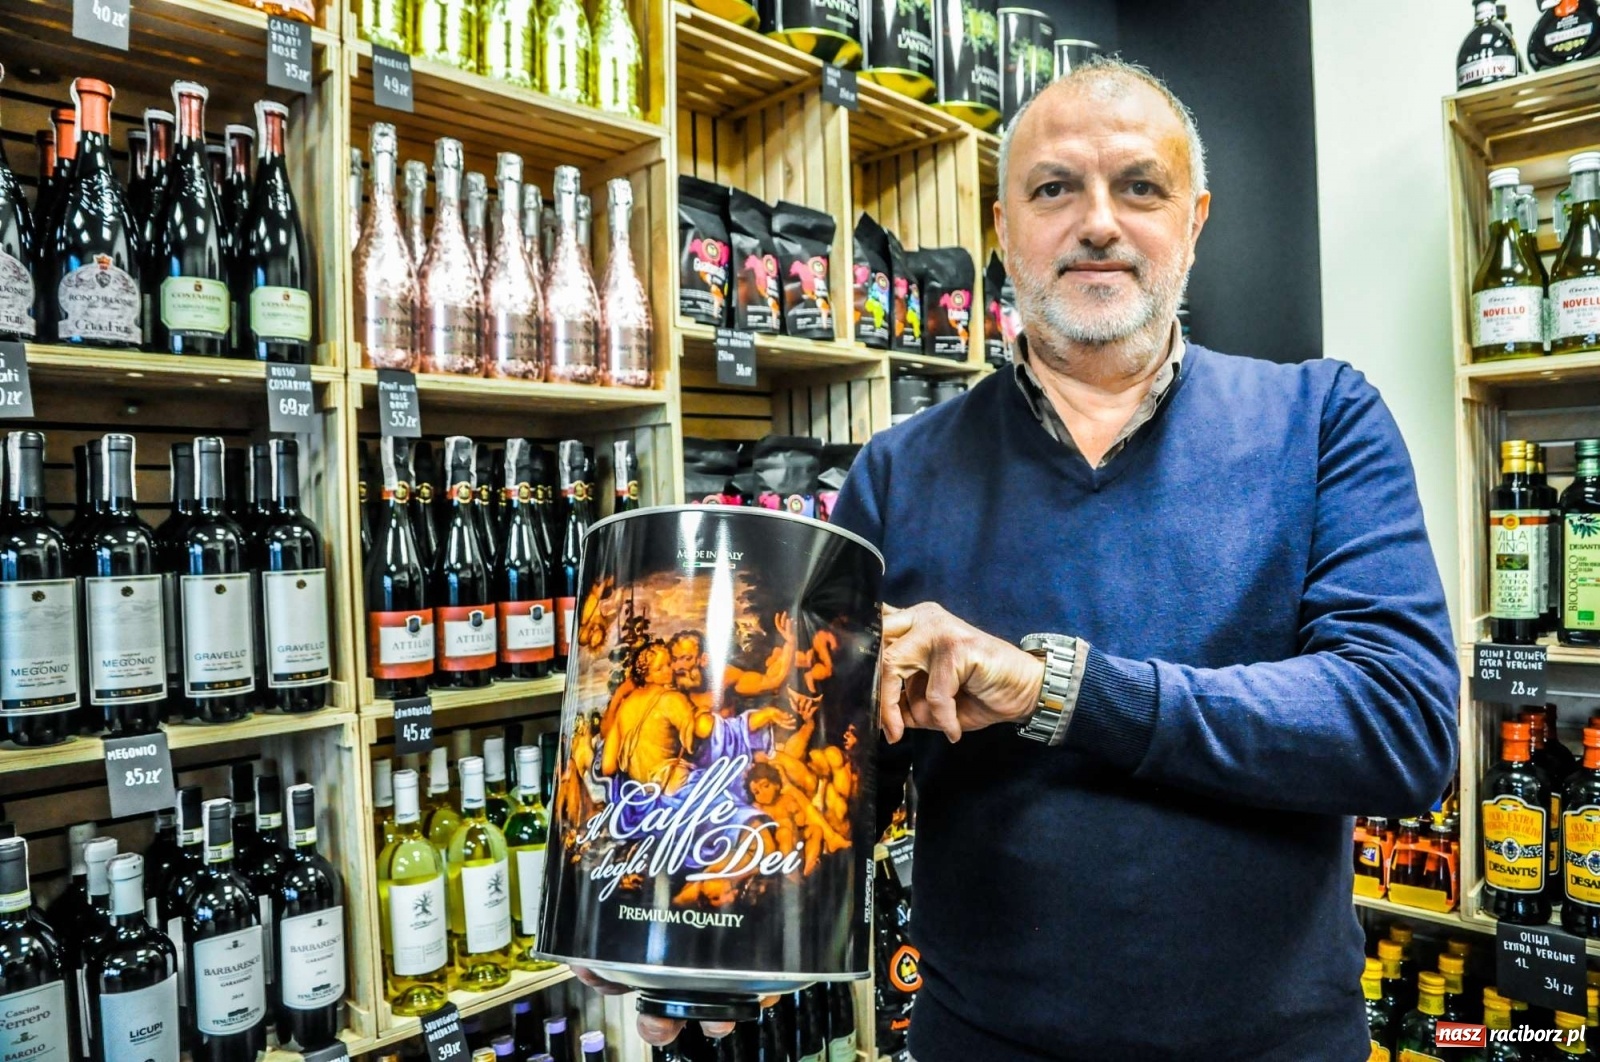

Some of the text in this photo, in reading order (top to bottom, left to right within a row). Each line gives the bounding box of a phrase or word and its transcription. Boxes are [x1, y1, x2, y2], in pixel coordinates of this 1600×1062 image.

[1483, 305, 1525, 318] NOVELLO
[676, 549, 705, 559] MDE
[1568, 554, 1579, 612] BIOLOGICO
[102, 655, 157, 668] MEGONIO
[1479, 649, 1547, 662] OLIWA Z OLIWEK
[1479, 657, 1543, 670] EXTRA VERGINE
[10, 663, 70, 677] MEGONIO
[1510, 680, 1526, 695] 28
[402, 722, 419, 743] 45
[106, 743, 158, 761] MEGONIO
[590, 822, 804, 902] degli Dei
[1488, 861, 1539, 879] DESANTIS
[618, 904, 744, 929] PREMIUM QUALITY
[1520, 931, 1550, 947] OLIWA
[1535, 947, 1577, 965] VERGINE
[1543, 976, 1560, 992] 34
[5, 1005, 41, 1019] Cascina
[4, 1043, 46, 1062] BAROLO
